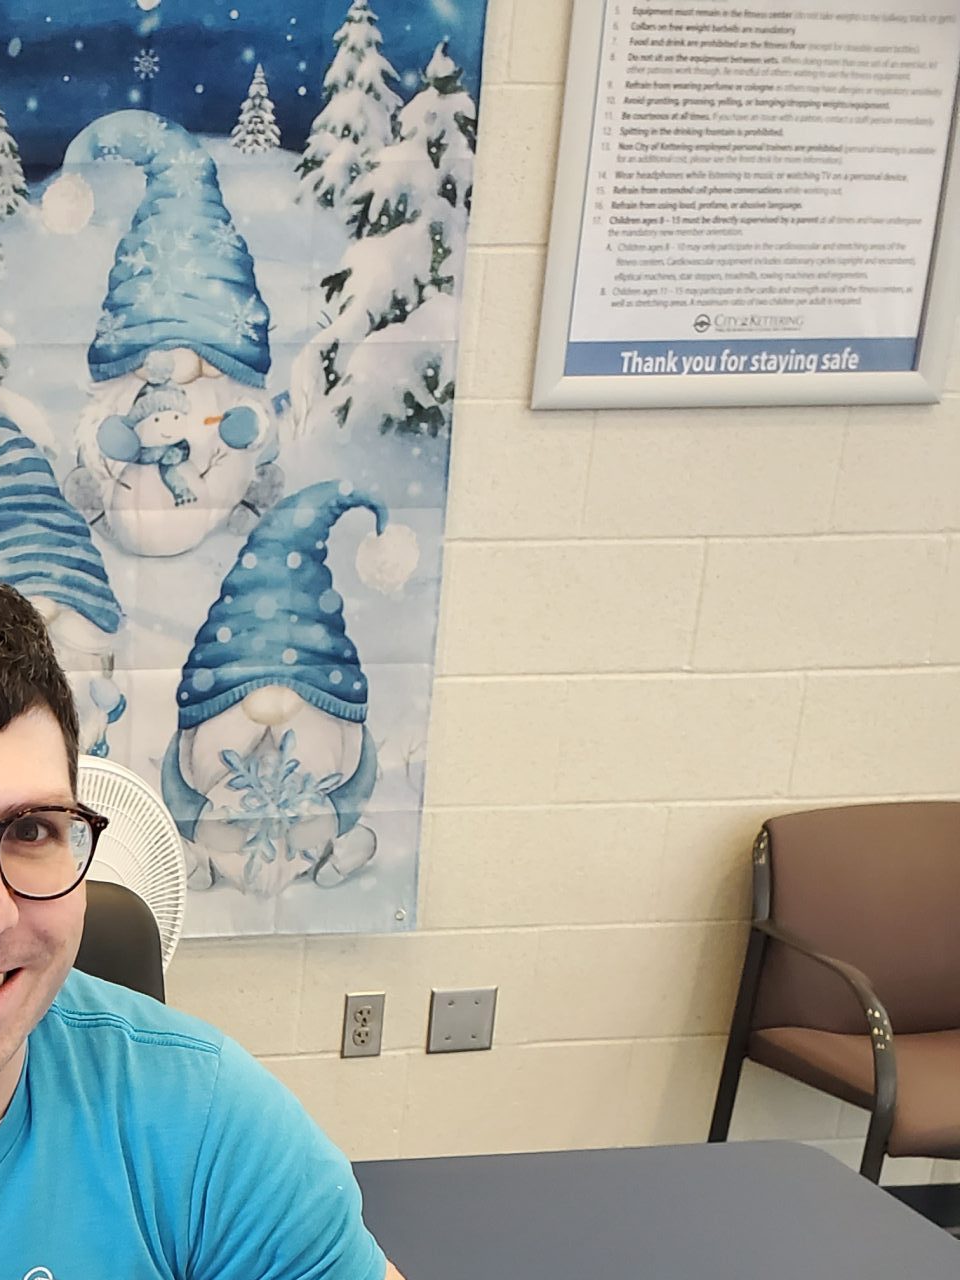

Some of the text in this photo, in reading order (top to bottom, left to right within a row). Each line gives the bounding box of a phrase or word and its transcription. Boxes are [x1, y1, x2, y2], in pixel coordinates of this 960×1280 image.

[620, 346, 860, 376] Thank you for staying safe
